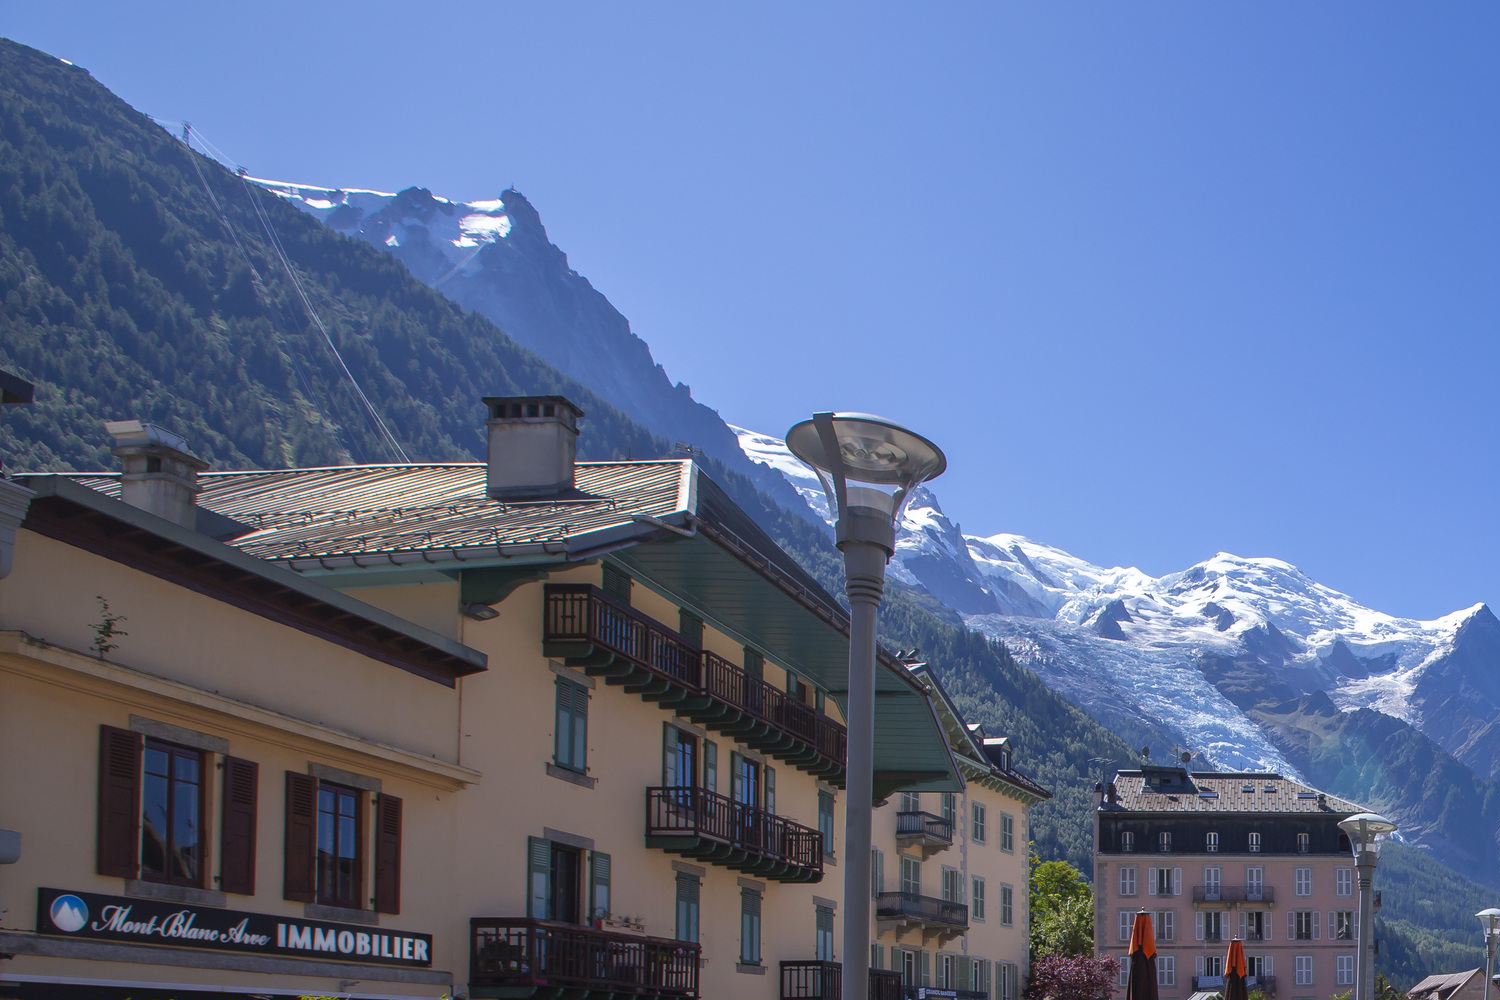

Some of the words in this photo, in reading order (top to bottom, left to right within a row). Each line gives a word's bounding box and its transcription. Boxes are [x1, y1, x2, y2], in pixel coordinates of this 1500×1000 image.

[91, 904, 219, 942] Mont-Blanc
[220, 917, 271, 946] Arve
[276, 923, 429, 961] IMMOBILIER
